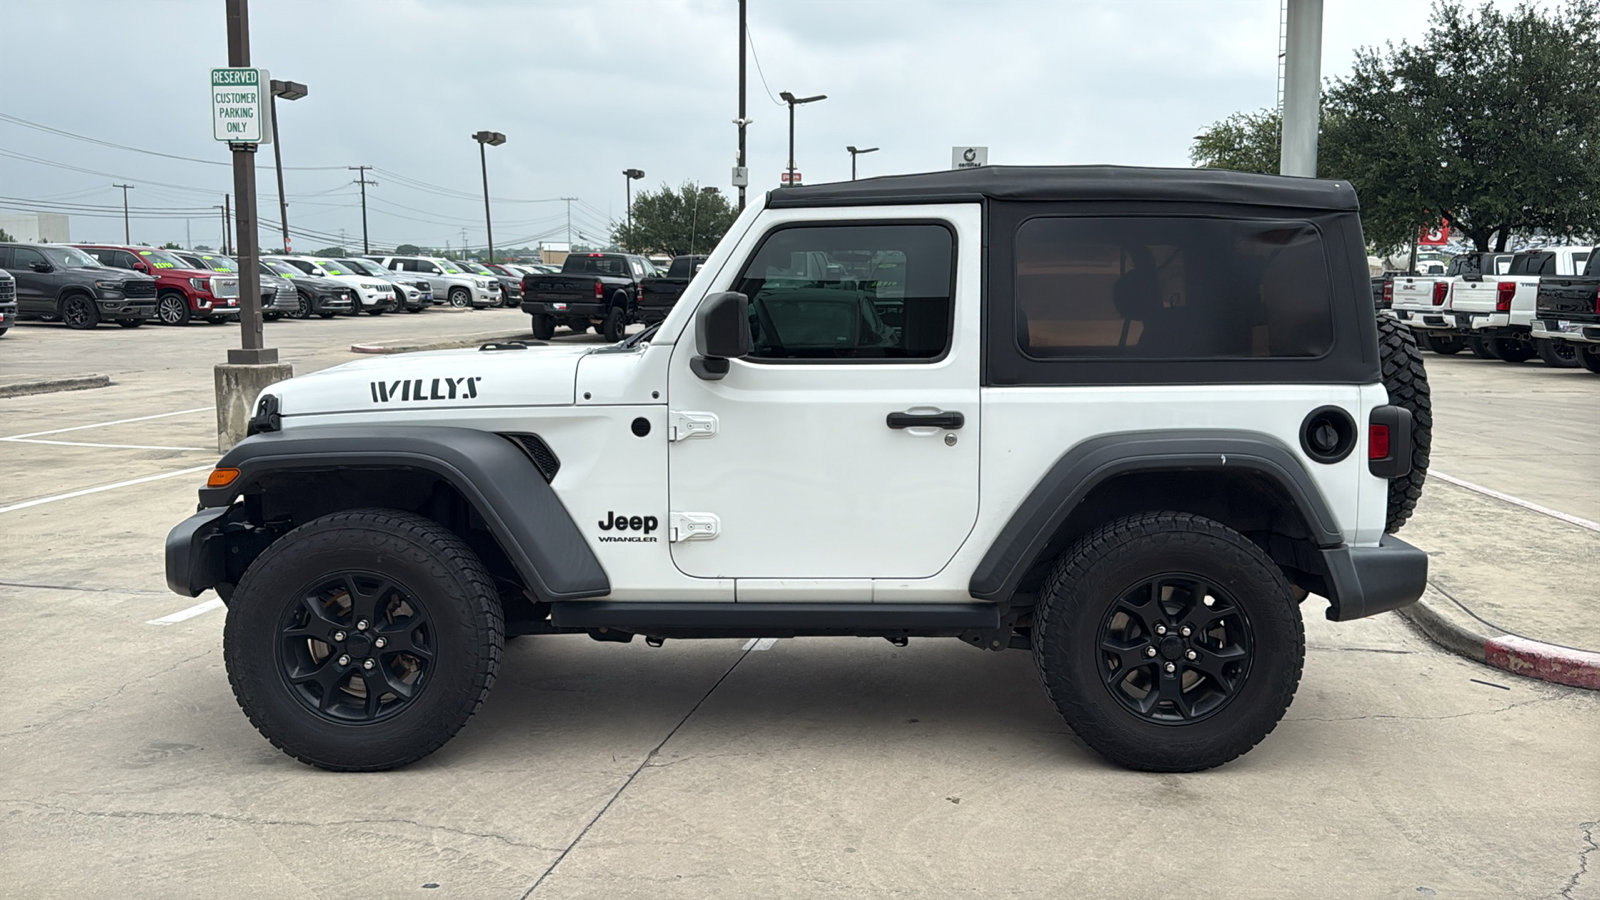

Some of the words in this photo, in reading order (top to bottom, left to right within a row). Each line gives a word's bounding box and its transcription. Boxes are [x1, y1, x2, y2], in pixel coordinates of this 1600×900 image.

[213, 71, 257, 83] RESERVED
[215, 92, 257, 104] CUSTOMER
[219, 107, 254, 118] PARKING
[226, 122, 247, 133] ONLY
[370, 376, 482, 403] WILLYS
[598, 511, 658, 535] Jeep
